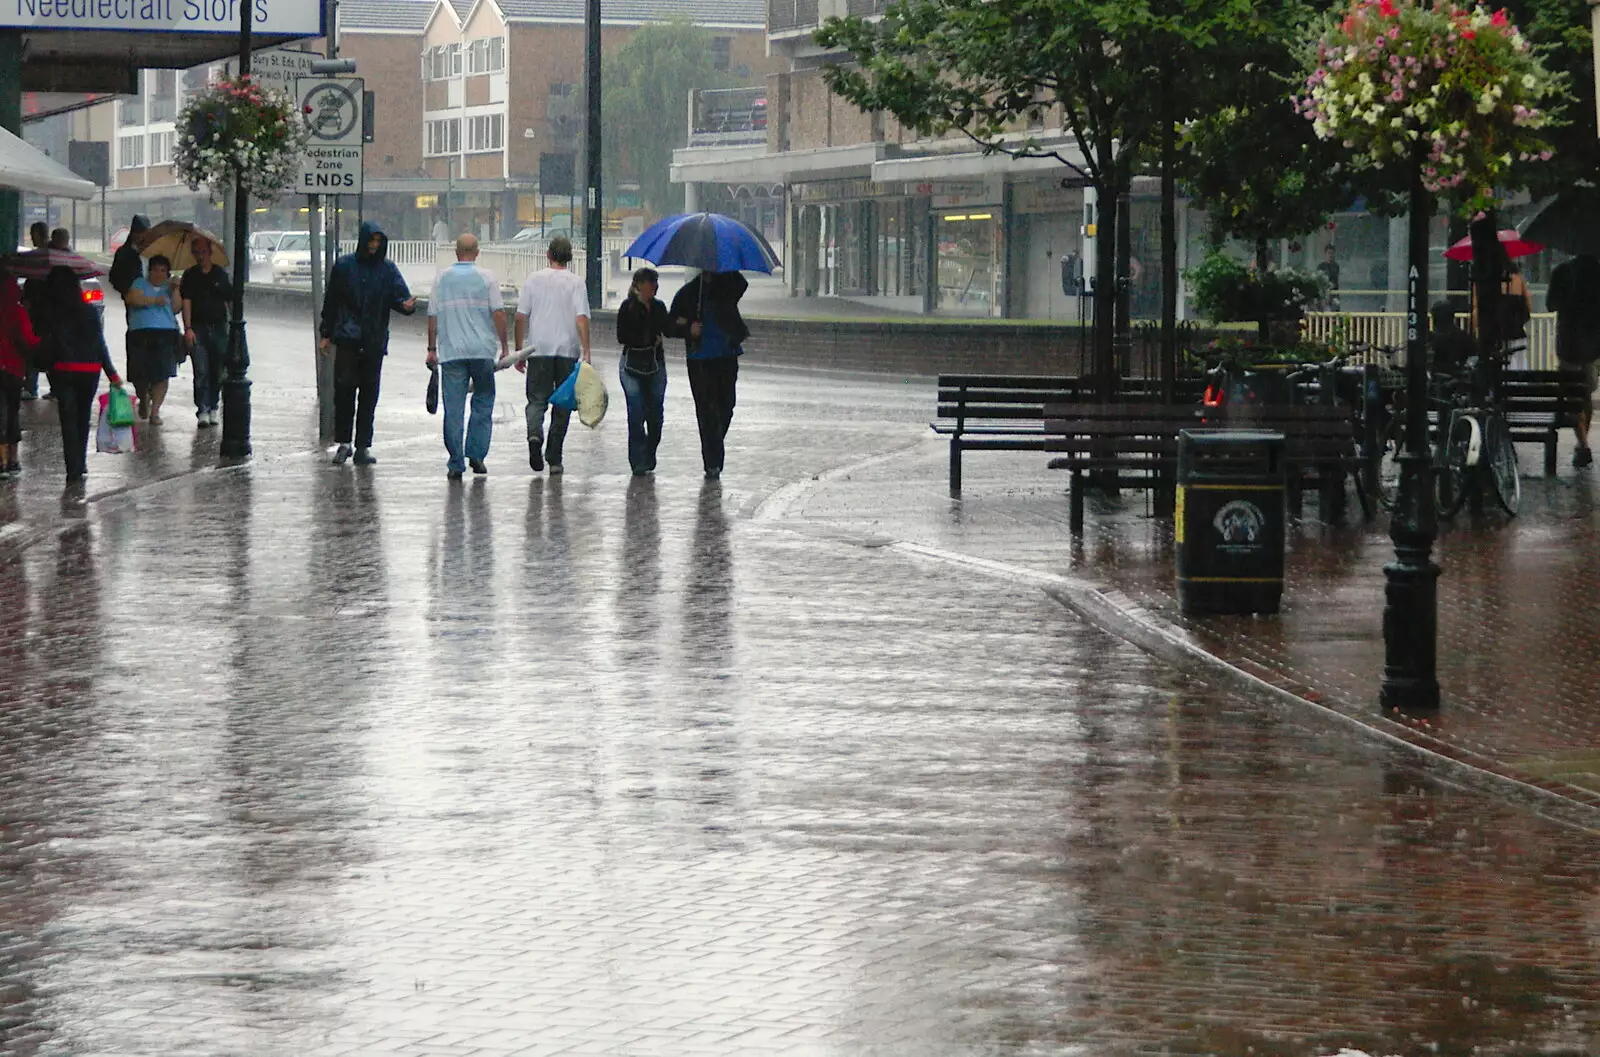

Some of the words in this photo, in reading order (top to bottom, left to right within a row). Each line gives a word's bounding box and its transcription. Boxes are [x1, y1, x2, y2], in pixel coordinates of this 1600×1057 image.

[183, 0, 268, 22] Stors
[253, 54, 269, 67] Bury
[316, 160, 343, 169] Zone
[304, 173, 354, 186] ENDS
